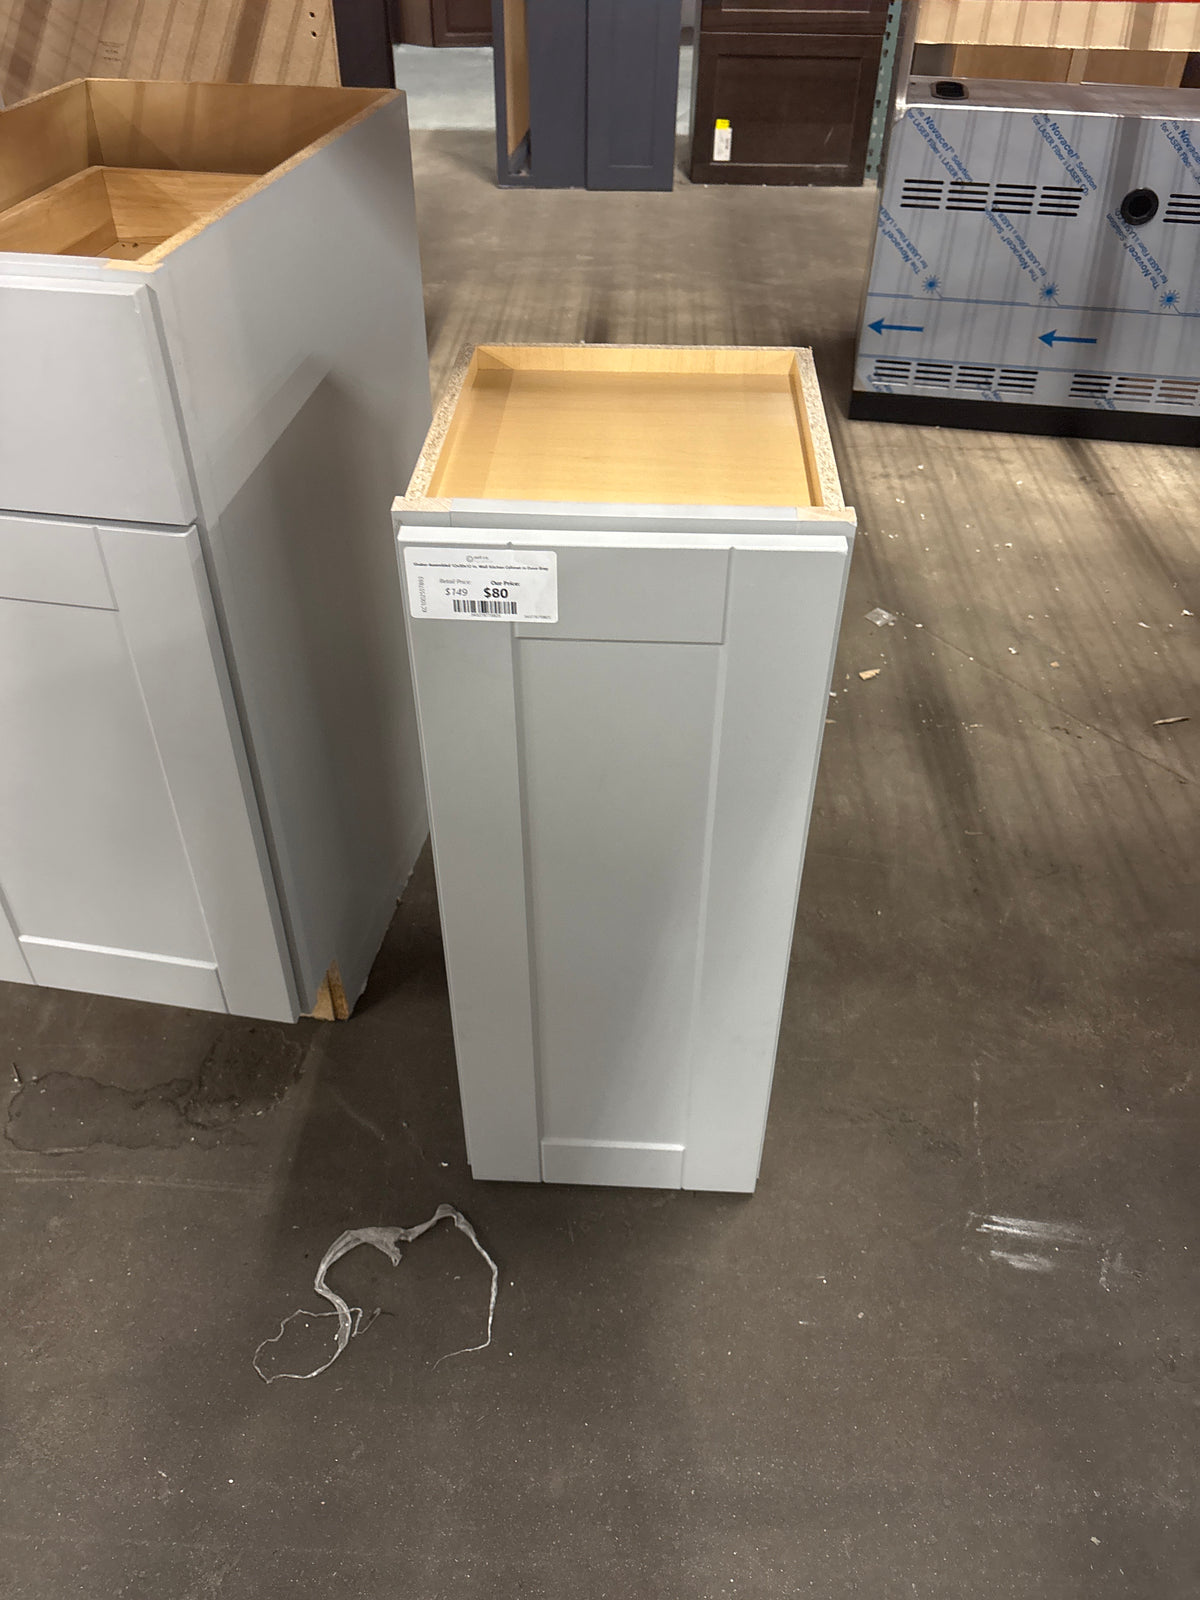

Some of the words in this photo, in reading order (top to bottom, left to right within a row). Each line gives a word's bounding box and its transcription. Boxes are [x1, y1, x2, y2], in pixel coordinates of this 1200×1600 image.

[913, 118, 929, 139] LASER
[941, 157, 958, 178] LASER
[1032, 115, 1041, 126] for
[1038, 124, 1055, 146] LASER
[1052, 144, 1065, 160] Fiber
[1066, 164, 1082, 184] LASER
[1160, 122, 1169, 133] for
[1166, 131, 1183, 153] LASER
[1180, 151, 1193, 168] Fiber
[1178, 129, 1200, 165] Novace
[1076, 161, 1097, 190] Solution
[1107, 213, 1127, 241] Solution
[906, 241, 922, 260] LASER
[1025, 248, 1041, 267] LASER
[910, 261, 920, 274] The
[1147, 256, 1163, 275] LASER
[1150, 276, 1160, 290] The
[445, 587, 468, 596] $149
[483, 587, 509, 599] $80
